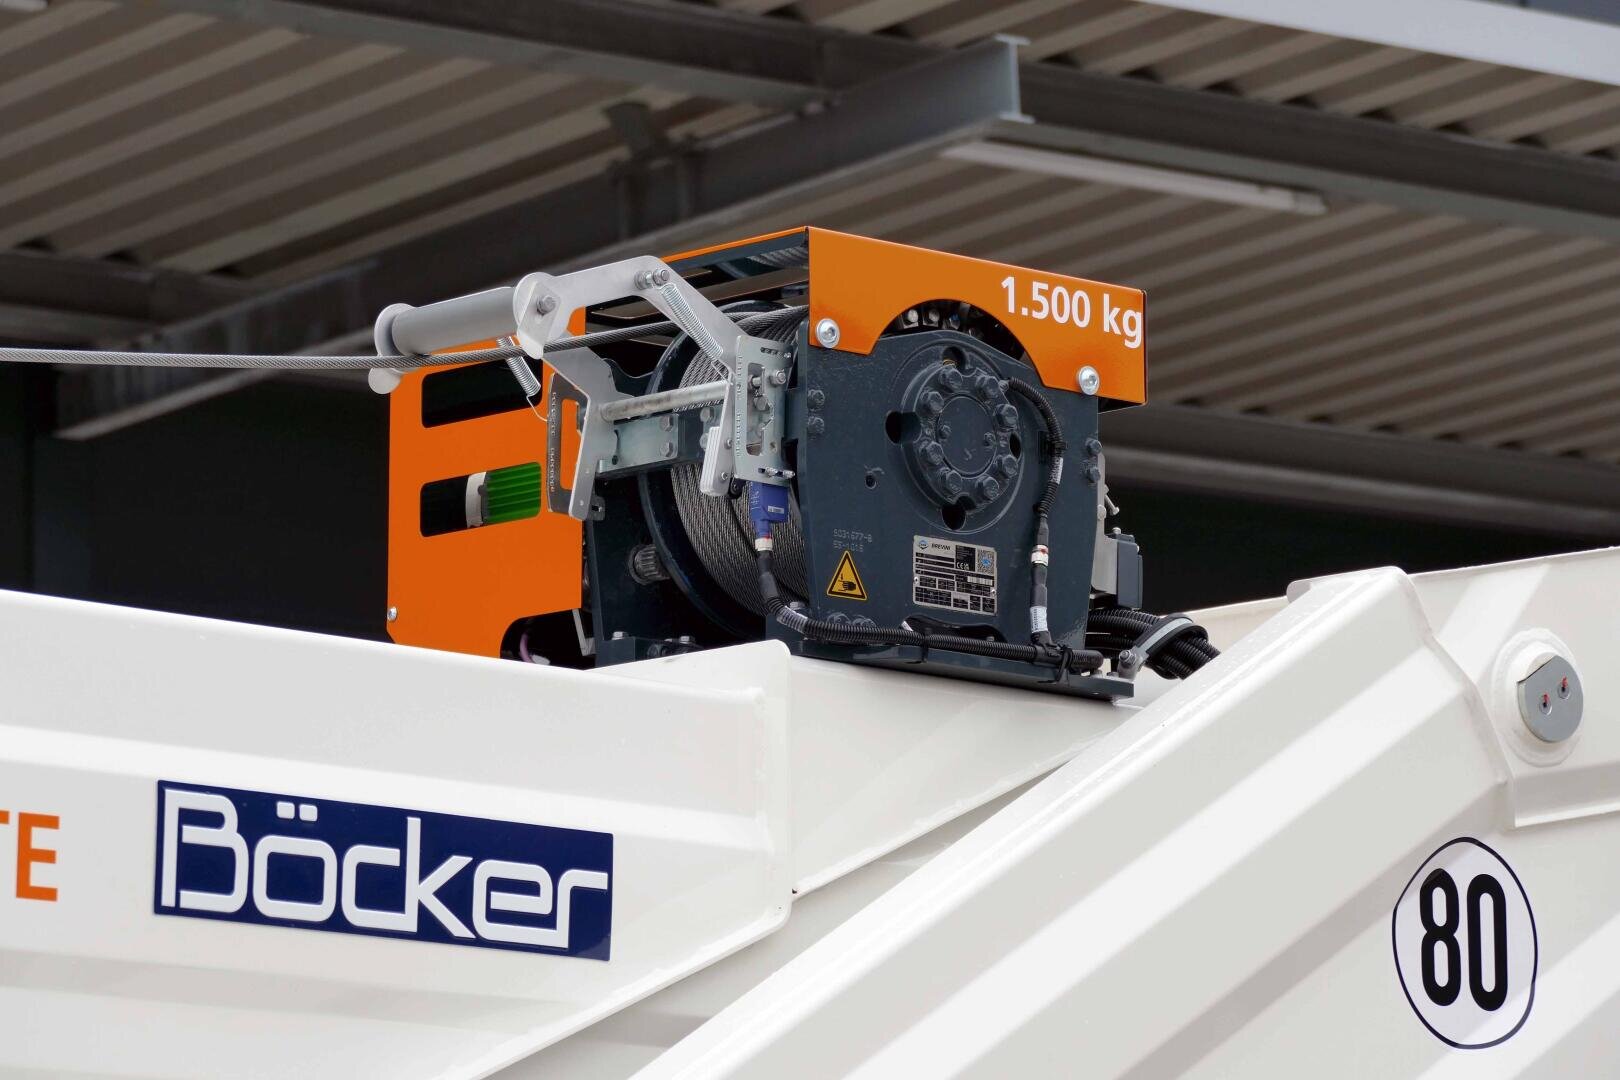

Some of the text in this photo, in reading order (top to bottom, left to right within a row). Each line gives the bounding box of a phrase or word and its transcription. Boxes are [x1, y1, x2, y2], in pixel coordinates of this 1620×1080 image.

[1001, 276, 1142, 349] 1.500 kg
[161, 788, 609, 949] Böcker
[1419, 868, 1508, 1012] 80
